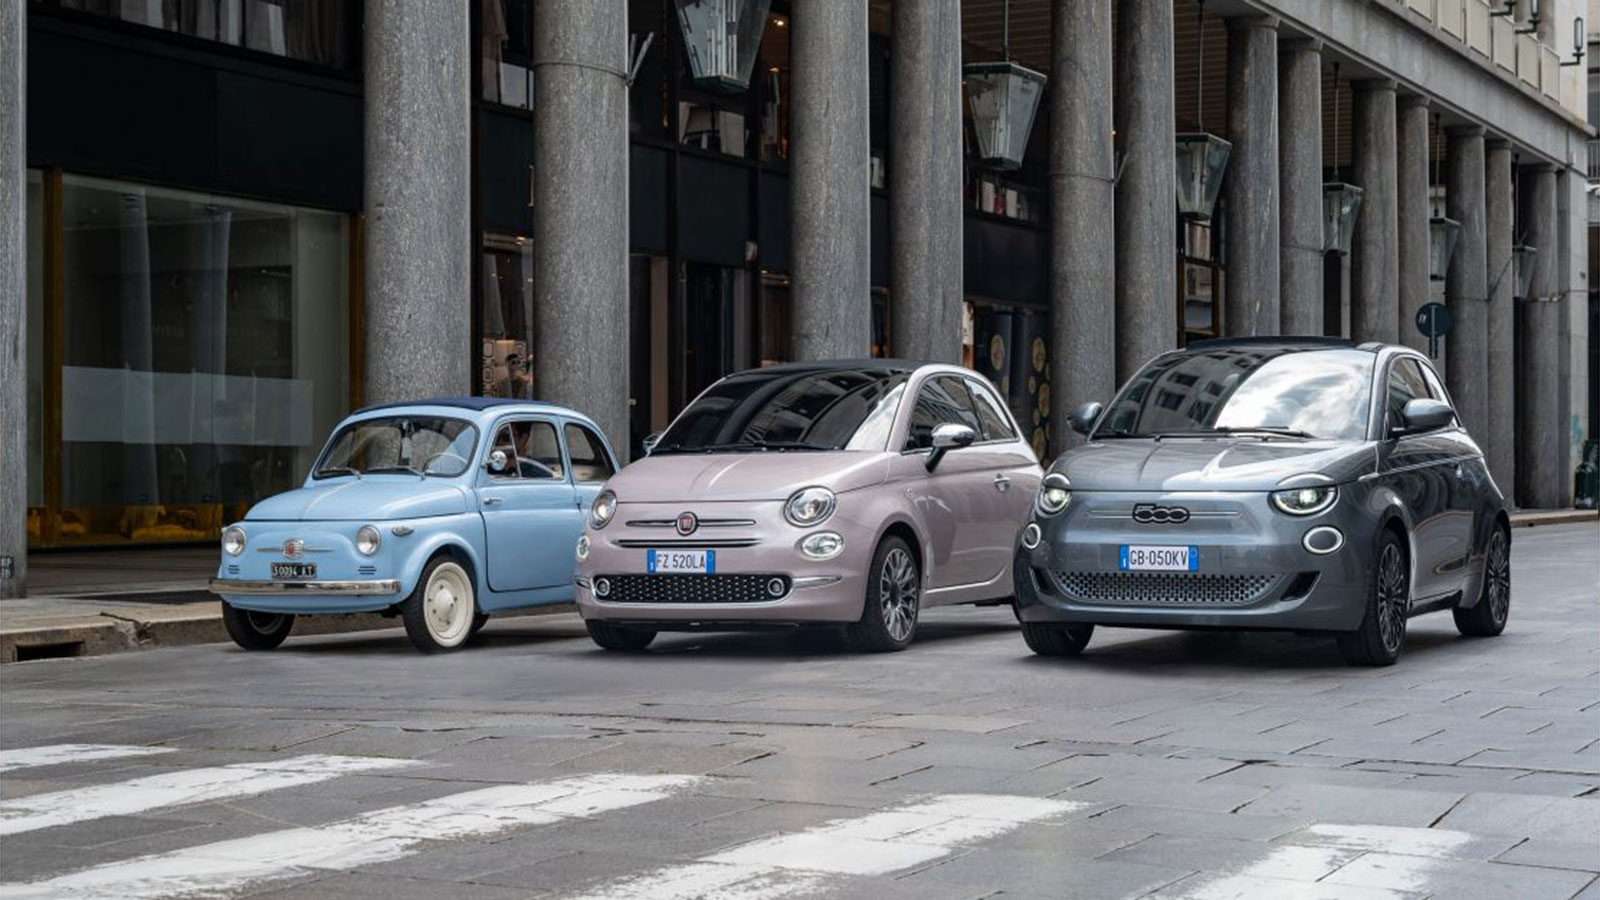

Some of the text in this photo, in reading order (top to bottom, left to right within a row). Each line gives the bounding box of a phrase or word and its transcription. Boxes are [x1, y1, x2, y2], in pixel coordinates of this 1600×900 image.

[1133, 503, 1190, 524] 500
[656, 554, 669, 569] FZ
[672, 554, 705, 569] 520LA
